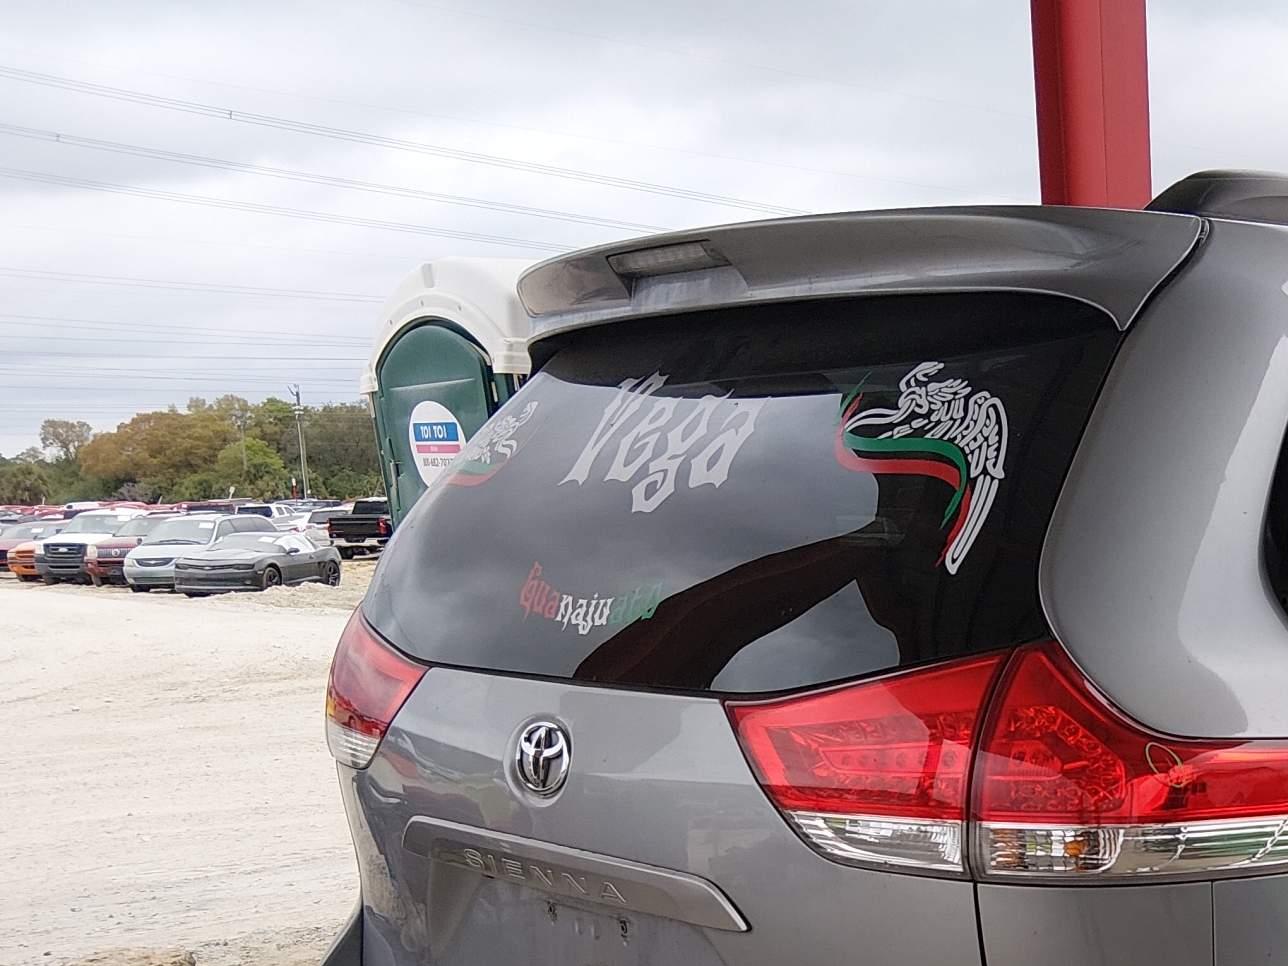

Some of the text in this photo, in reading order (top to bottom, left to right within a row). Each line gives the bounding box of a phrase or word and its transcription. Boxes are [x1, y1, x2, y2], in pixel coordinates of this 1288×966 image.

[420, 425, 447, 439] TOI TOI
[557, 370, 767, 513] Vega
[464, 848, 627, 903] SIENNA
